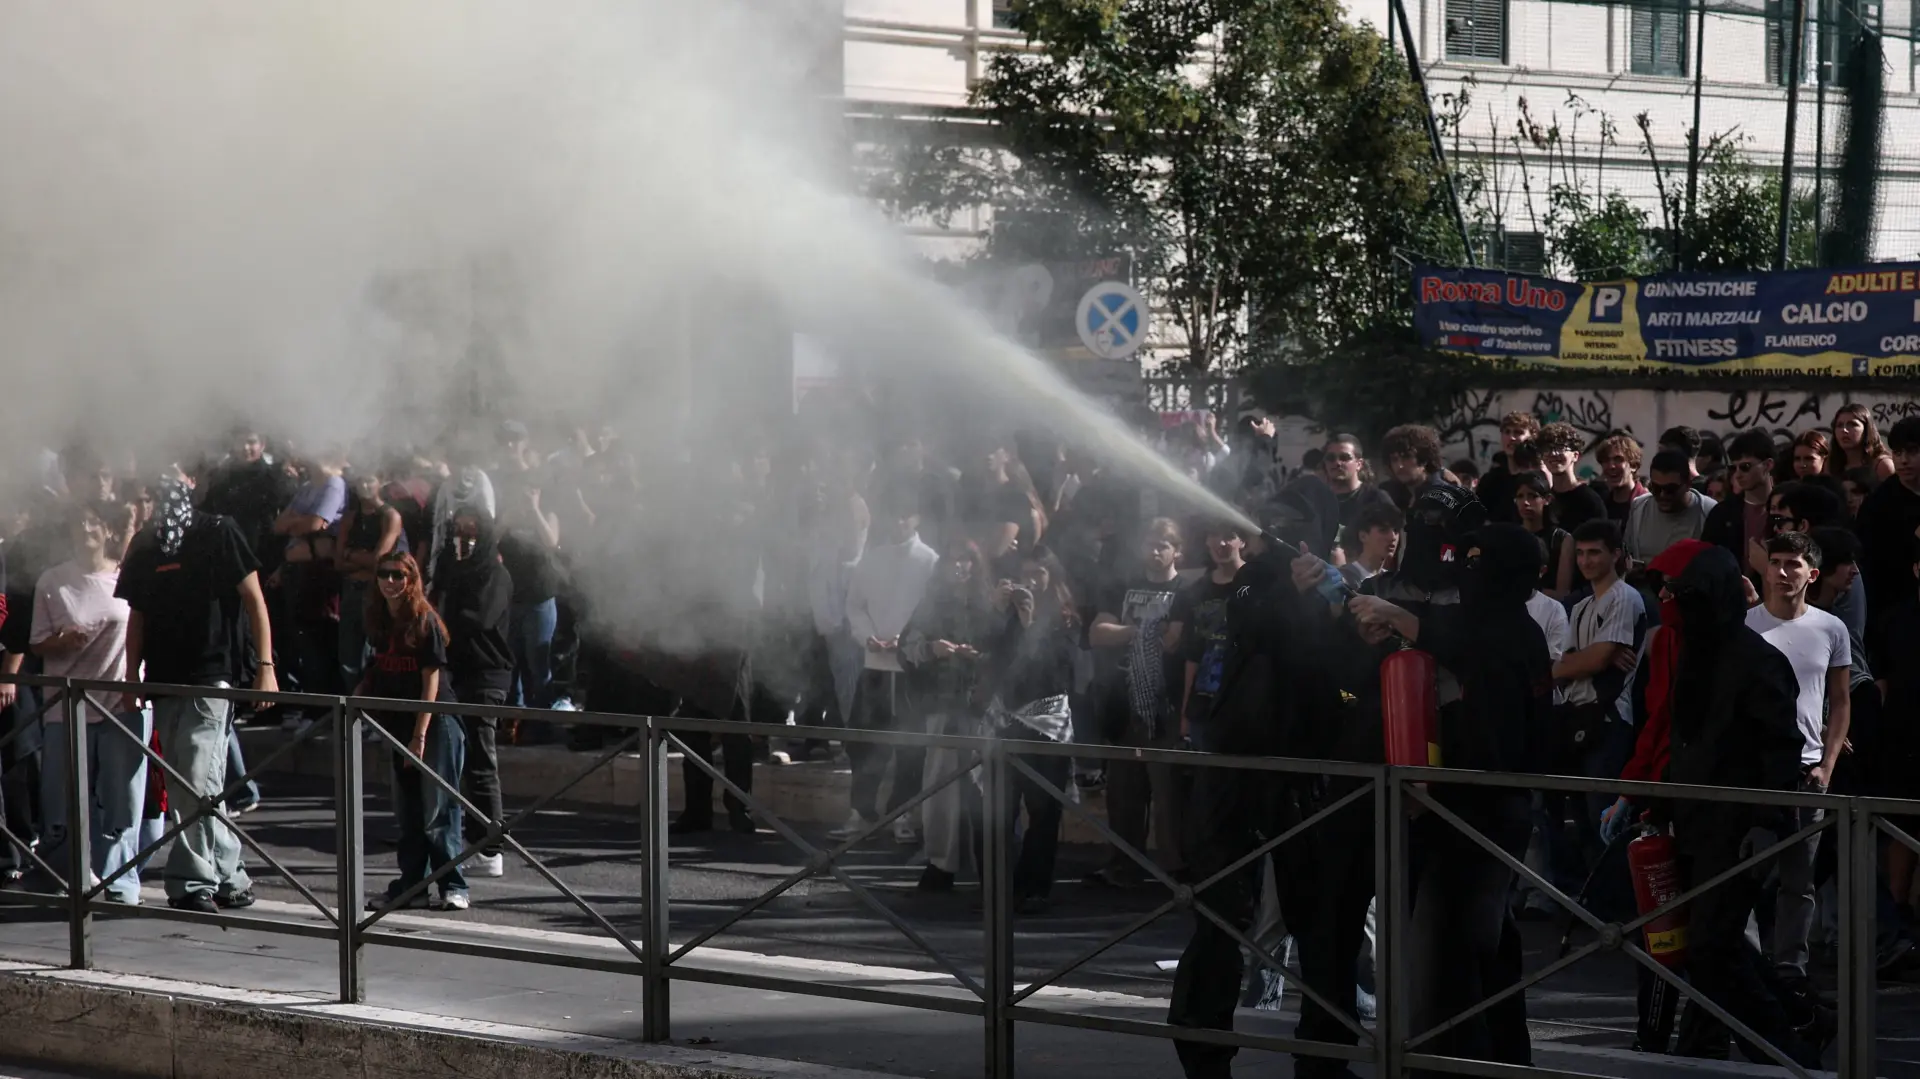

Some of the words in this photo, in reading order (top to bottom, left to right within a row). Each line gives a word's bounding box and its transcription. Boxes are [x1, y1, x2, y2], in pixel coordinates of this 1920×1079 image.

[1644, 281, 1757, 298] GINNASTICHE
[1826, 271, 1896, 294] ADULTI
[1900, 270, 1915, 290] E
[1421, 276, 1501, 304] Roma
[1506, 277, 1566, 311] Uno
[1594, 287, 1621, 317] P
[1647, 312, 1682, 326] ARTI
[1685, 310, 1761, 326] MARZIALI
[1781, 301, 1868, 324] CALCIO
[1498, 325, 1542, 337] sportivo
[1482, 338, 1494, 348] di
[1496, 339, 1551, 351] Trastevere
[1654, 338, 1737, 357] FITNESS
[1764, 334, 1837, 347] FLAMENCO
